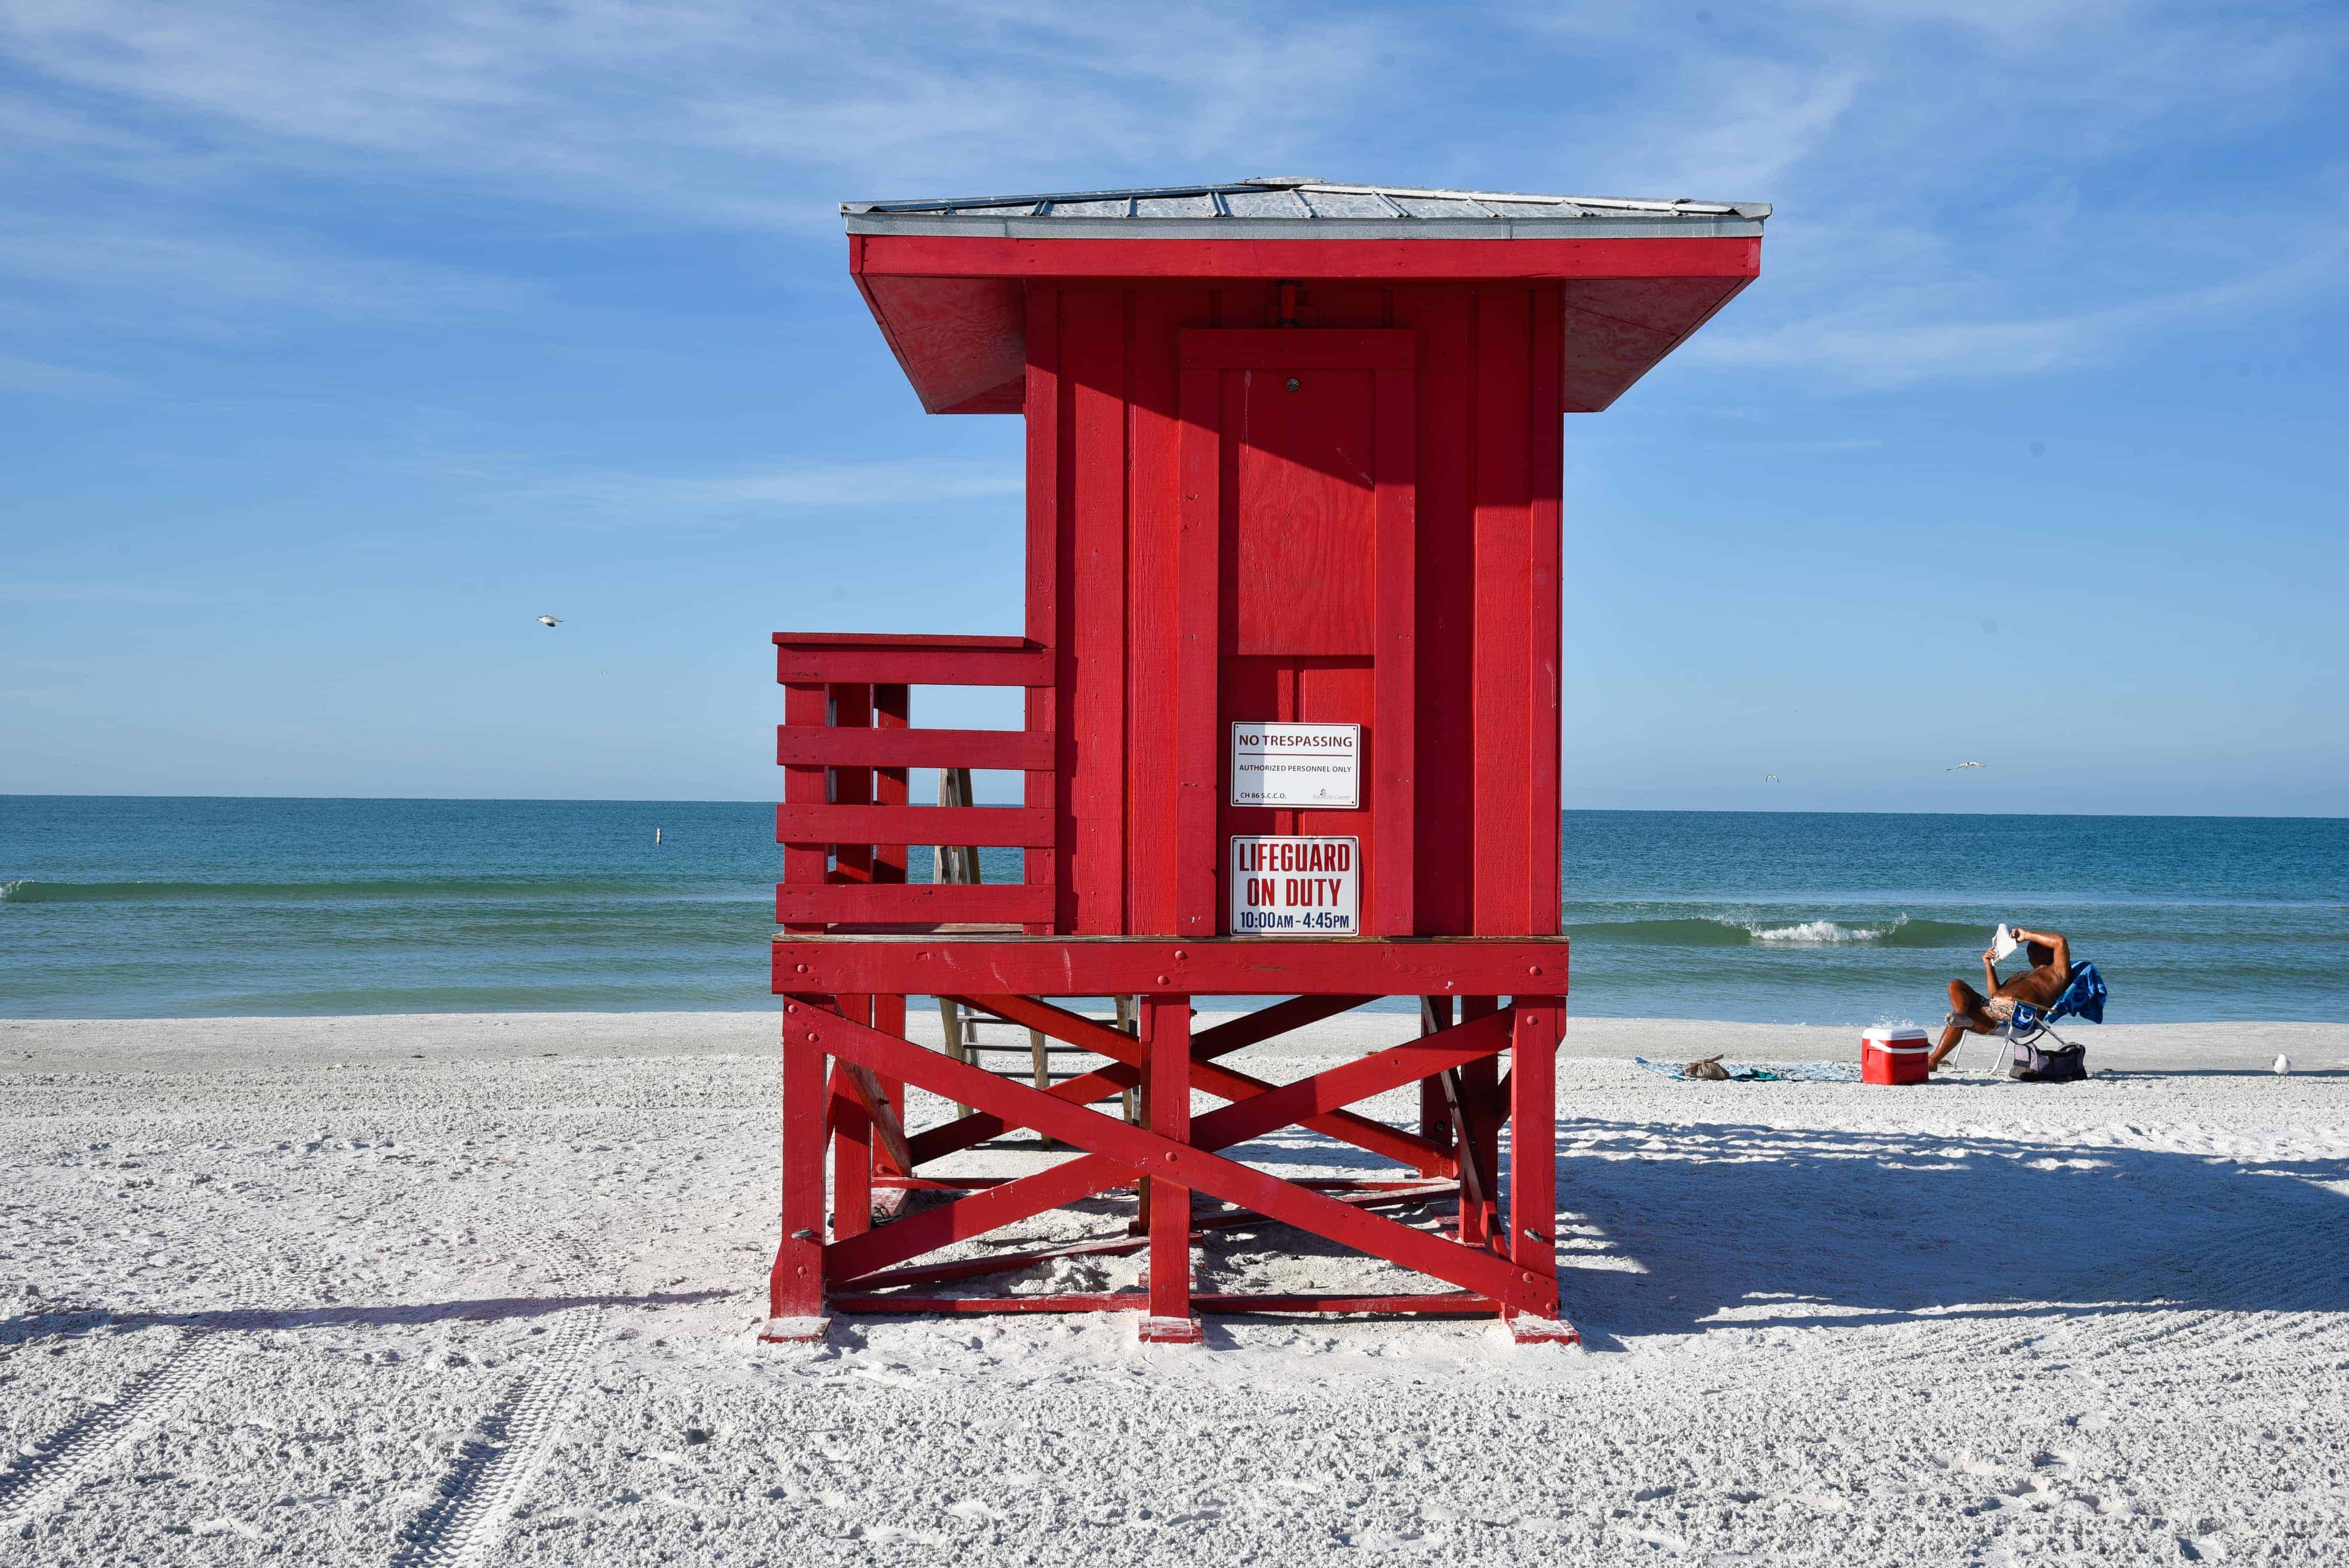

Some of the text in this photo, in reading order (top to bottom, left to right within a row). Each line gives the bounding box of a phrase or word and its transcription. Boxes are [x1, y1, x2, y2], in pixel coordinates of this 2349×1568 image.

[1239, 735, 1352, 747] NO TRESPASSING
[1239, 844, 1350, 871] LIFEGUARD
[1247, 879, 1341, 906] ON DUTY
